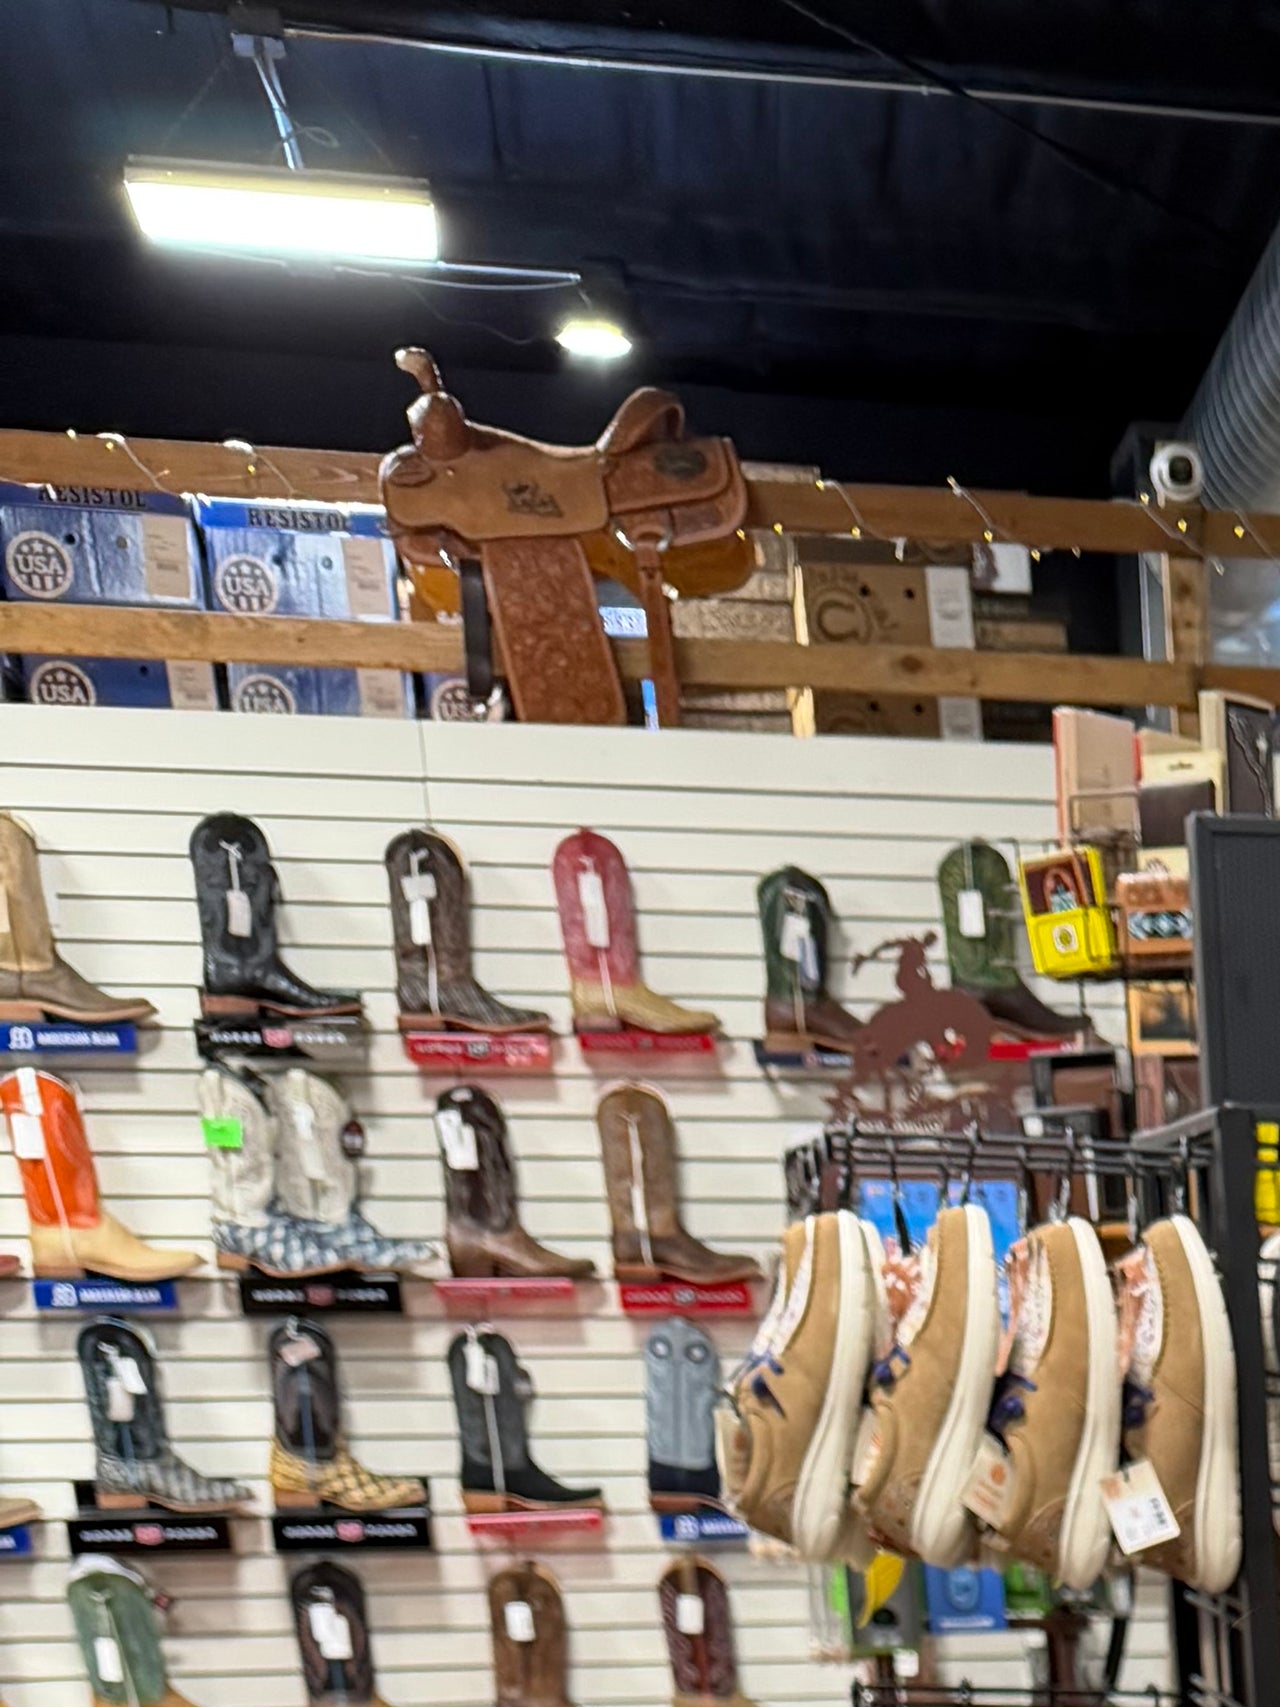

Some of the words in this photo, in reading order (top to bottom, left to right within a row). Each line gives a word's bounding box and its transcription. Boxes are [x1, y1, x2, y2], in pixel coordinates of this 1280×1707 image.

[15, 553, 63, 576] USA
[225, 575, 269, 597] USA
[40, 684, 86, 704] USA
